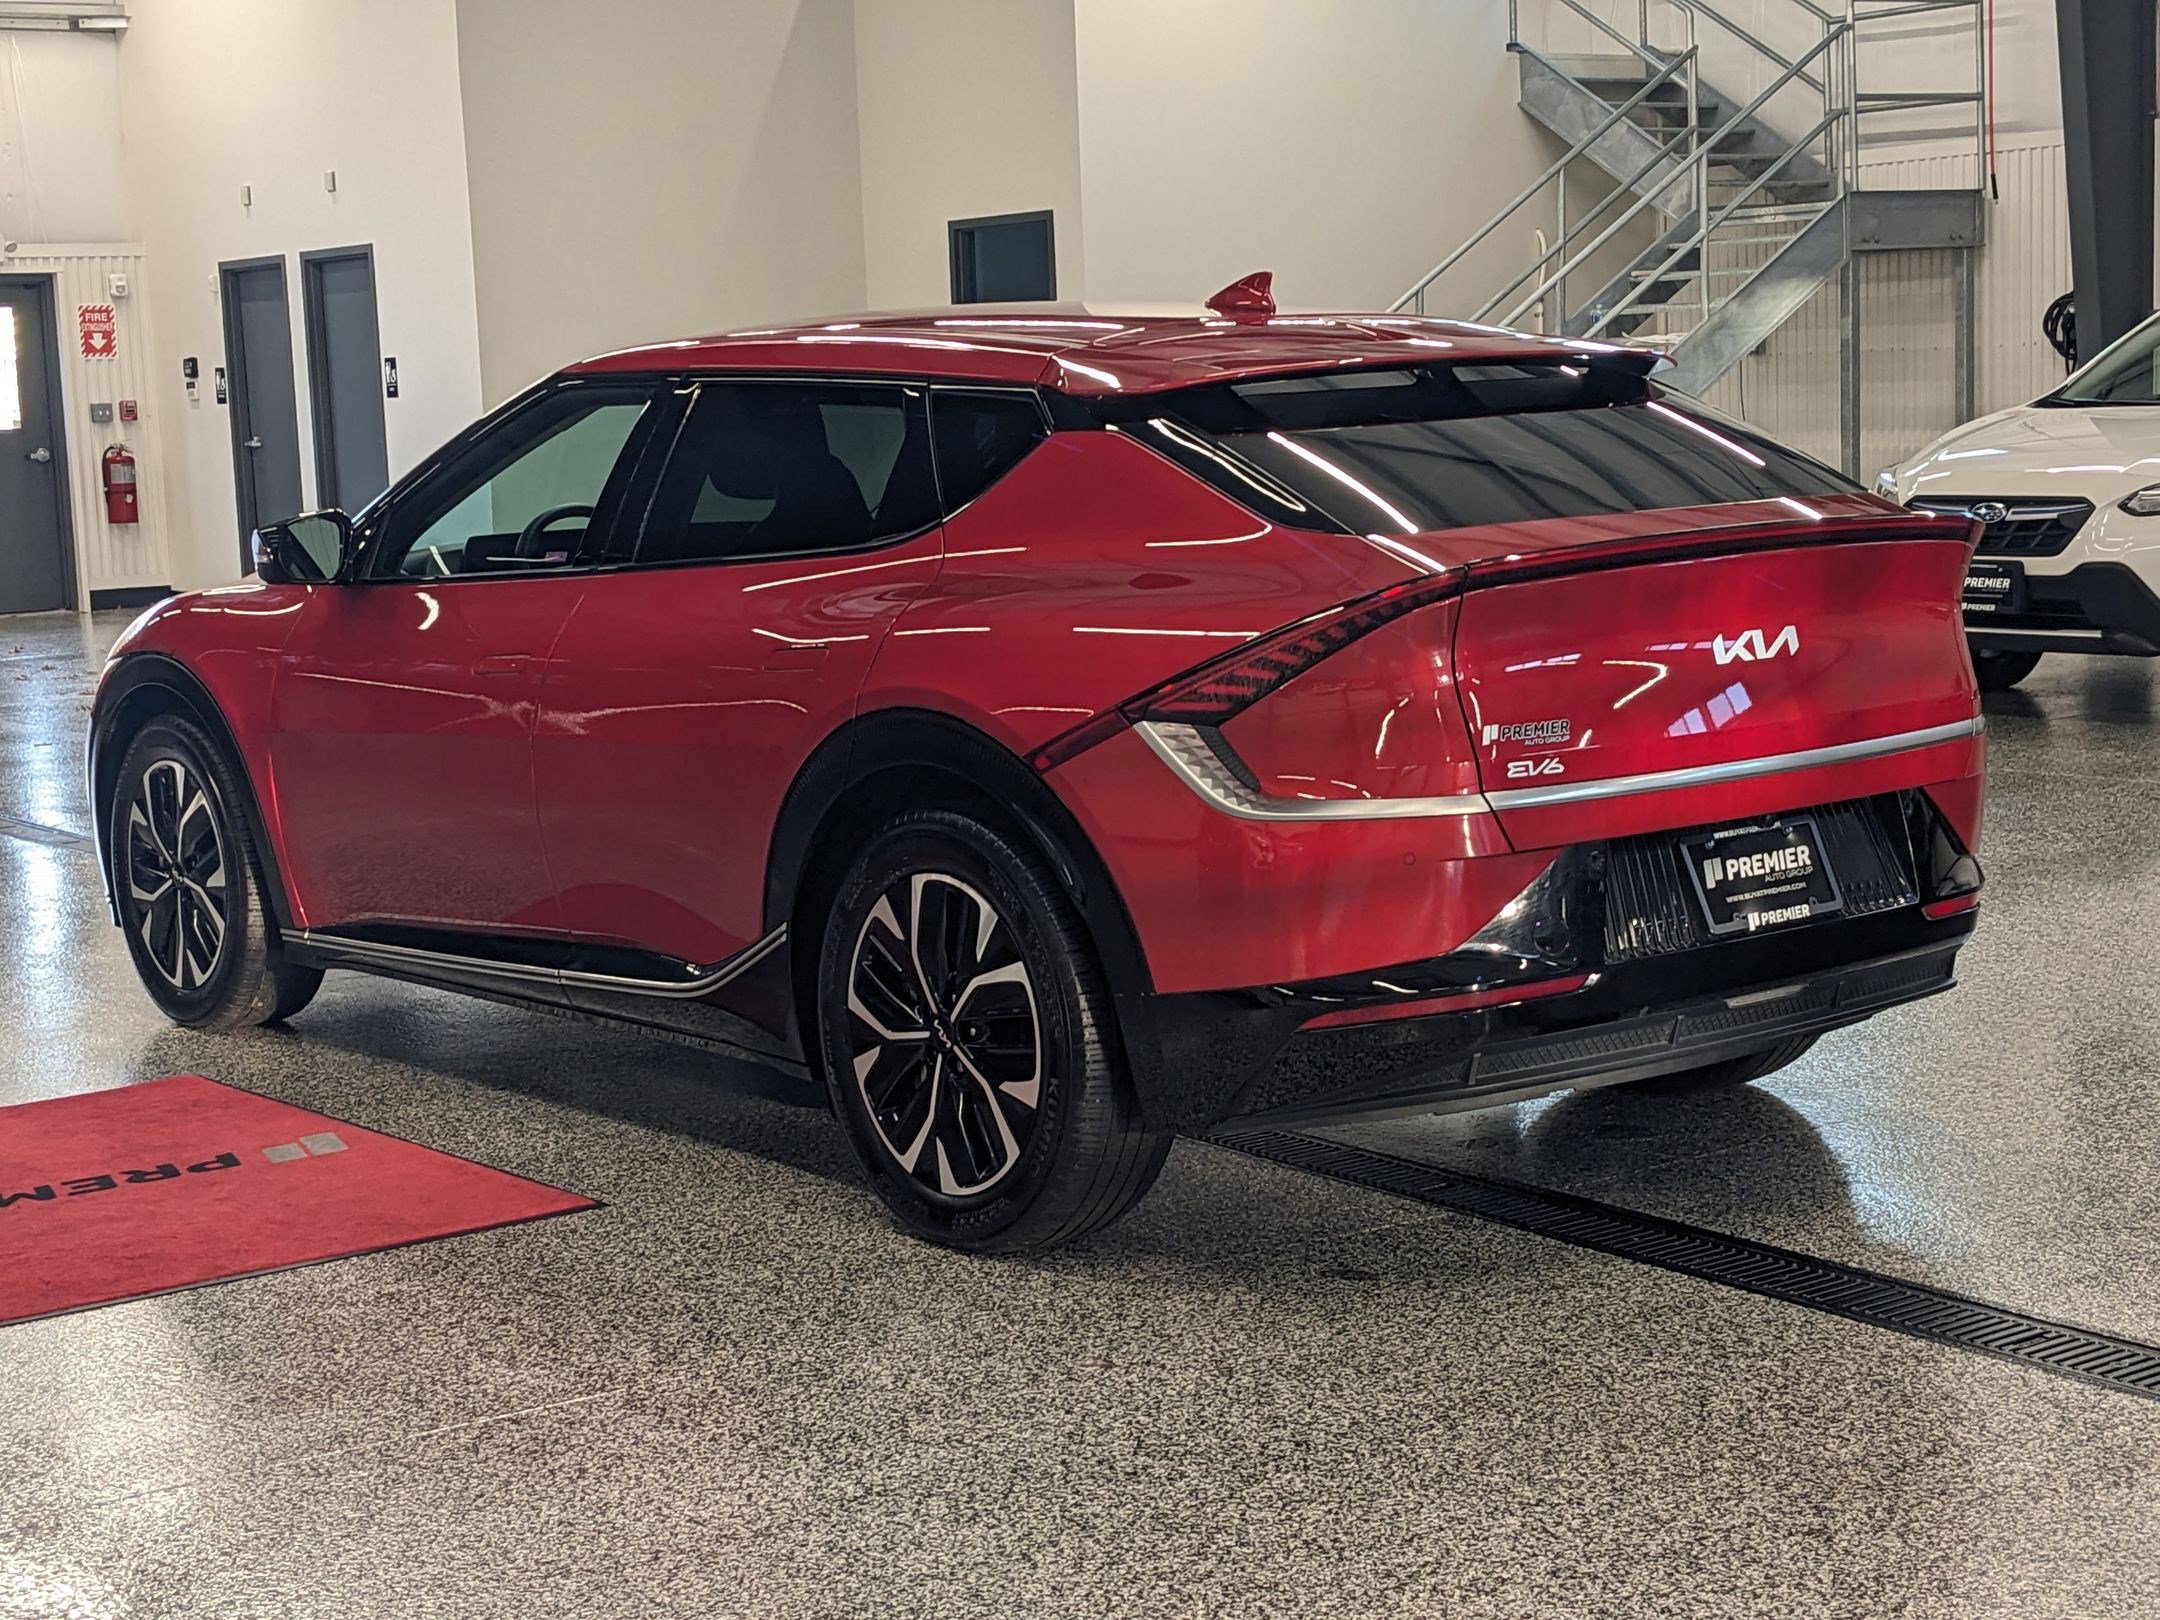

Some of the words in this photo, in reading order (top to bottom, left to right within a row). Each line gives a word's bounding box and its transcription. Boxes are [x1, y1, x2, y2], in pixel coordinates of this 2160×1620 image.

[85, 312, 108, 322] FIRE
[1963, 576, 2011, 589] PREMIER
[1712, 625, 1800, 665] KIA
[1500, 719, 1571, 742] PREMIER
[1524, 738, 1544, 746] AUTO
[1545, 734, 1571, 744] GROUP
[1507, 757, 1565, 778] EV6
[1725, 844, 1812, 881] PREMIER
[1764, 871, 1786, 882] AUTO
[1786, 865, 1814, 878] GROUP
[1760, 903, 1811, 926] PREMIER
